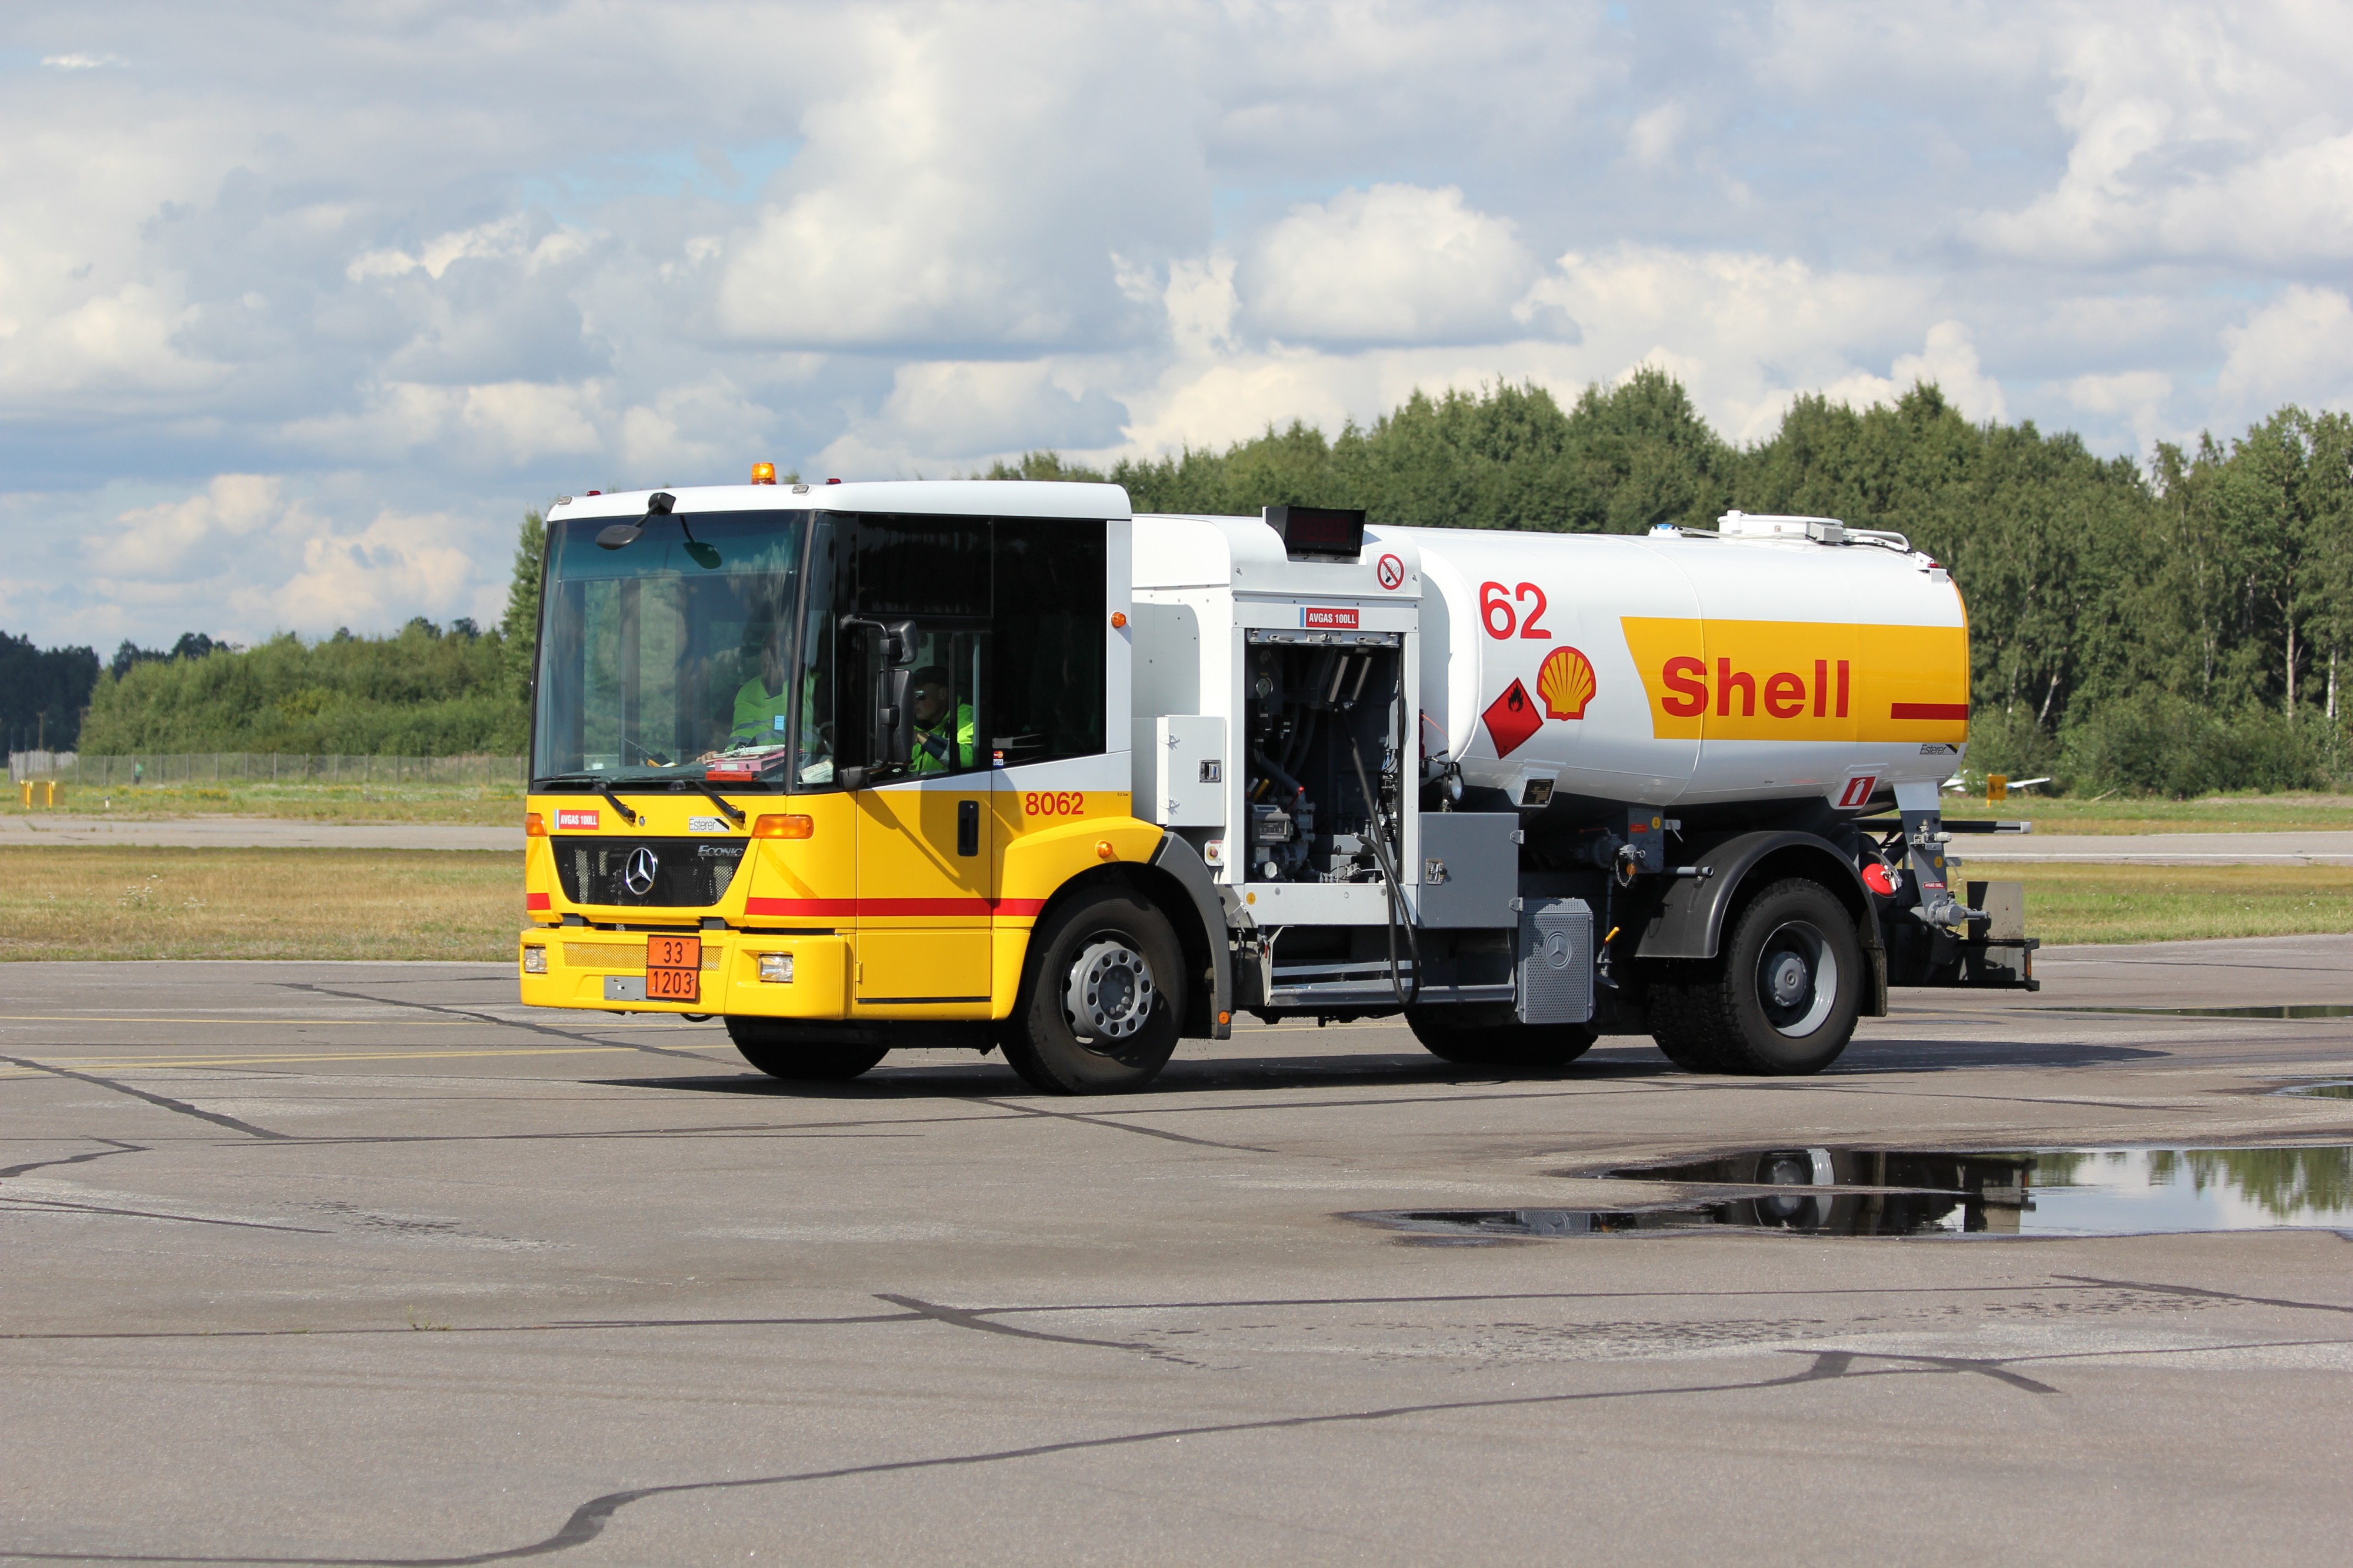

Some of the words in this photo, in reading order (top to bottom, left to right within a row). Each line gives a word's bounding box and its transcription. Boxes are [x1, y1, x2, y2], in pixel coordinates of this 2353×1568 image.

[1308, 612, 1333, 623] AVGAS
[1335, 613, 1356, 624] 100LL
[1479, 581, 1552, 640] 62
[1661, 656, 1849, 719] Shell
[1920, 744, 1947, 755] Esterer
[1025, 792, 1084, 816] 8062
[560, 815, 579, 825] AVGAS
[580, 815, 597, 825] 100LL
[689, 818, 716, 830] Esterer
[664, 941, 682, 963] 33
[654, 970, 692, 994] 1203
